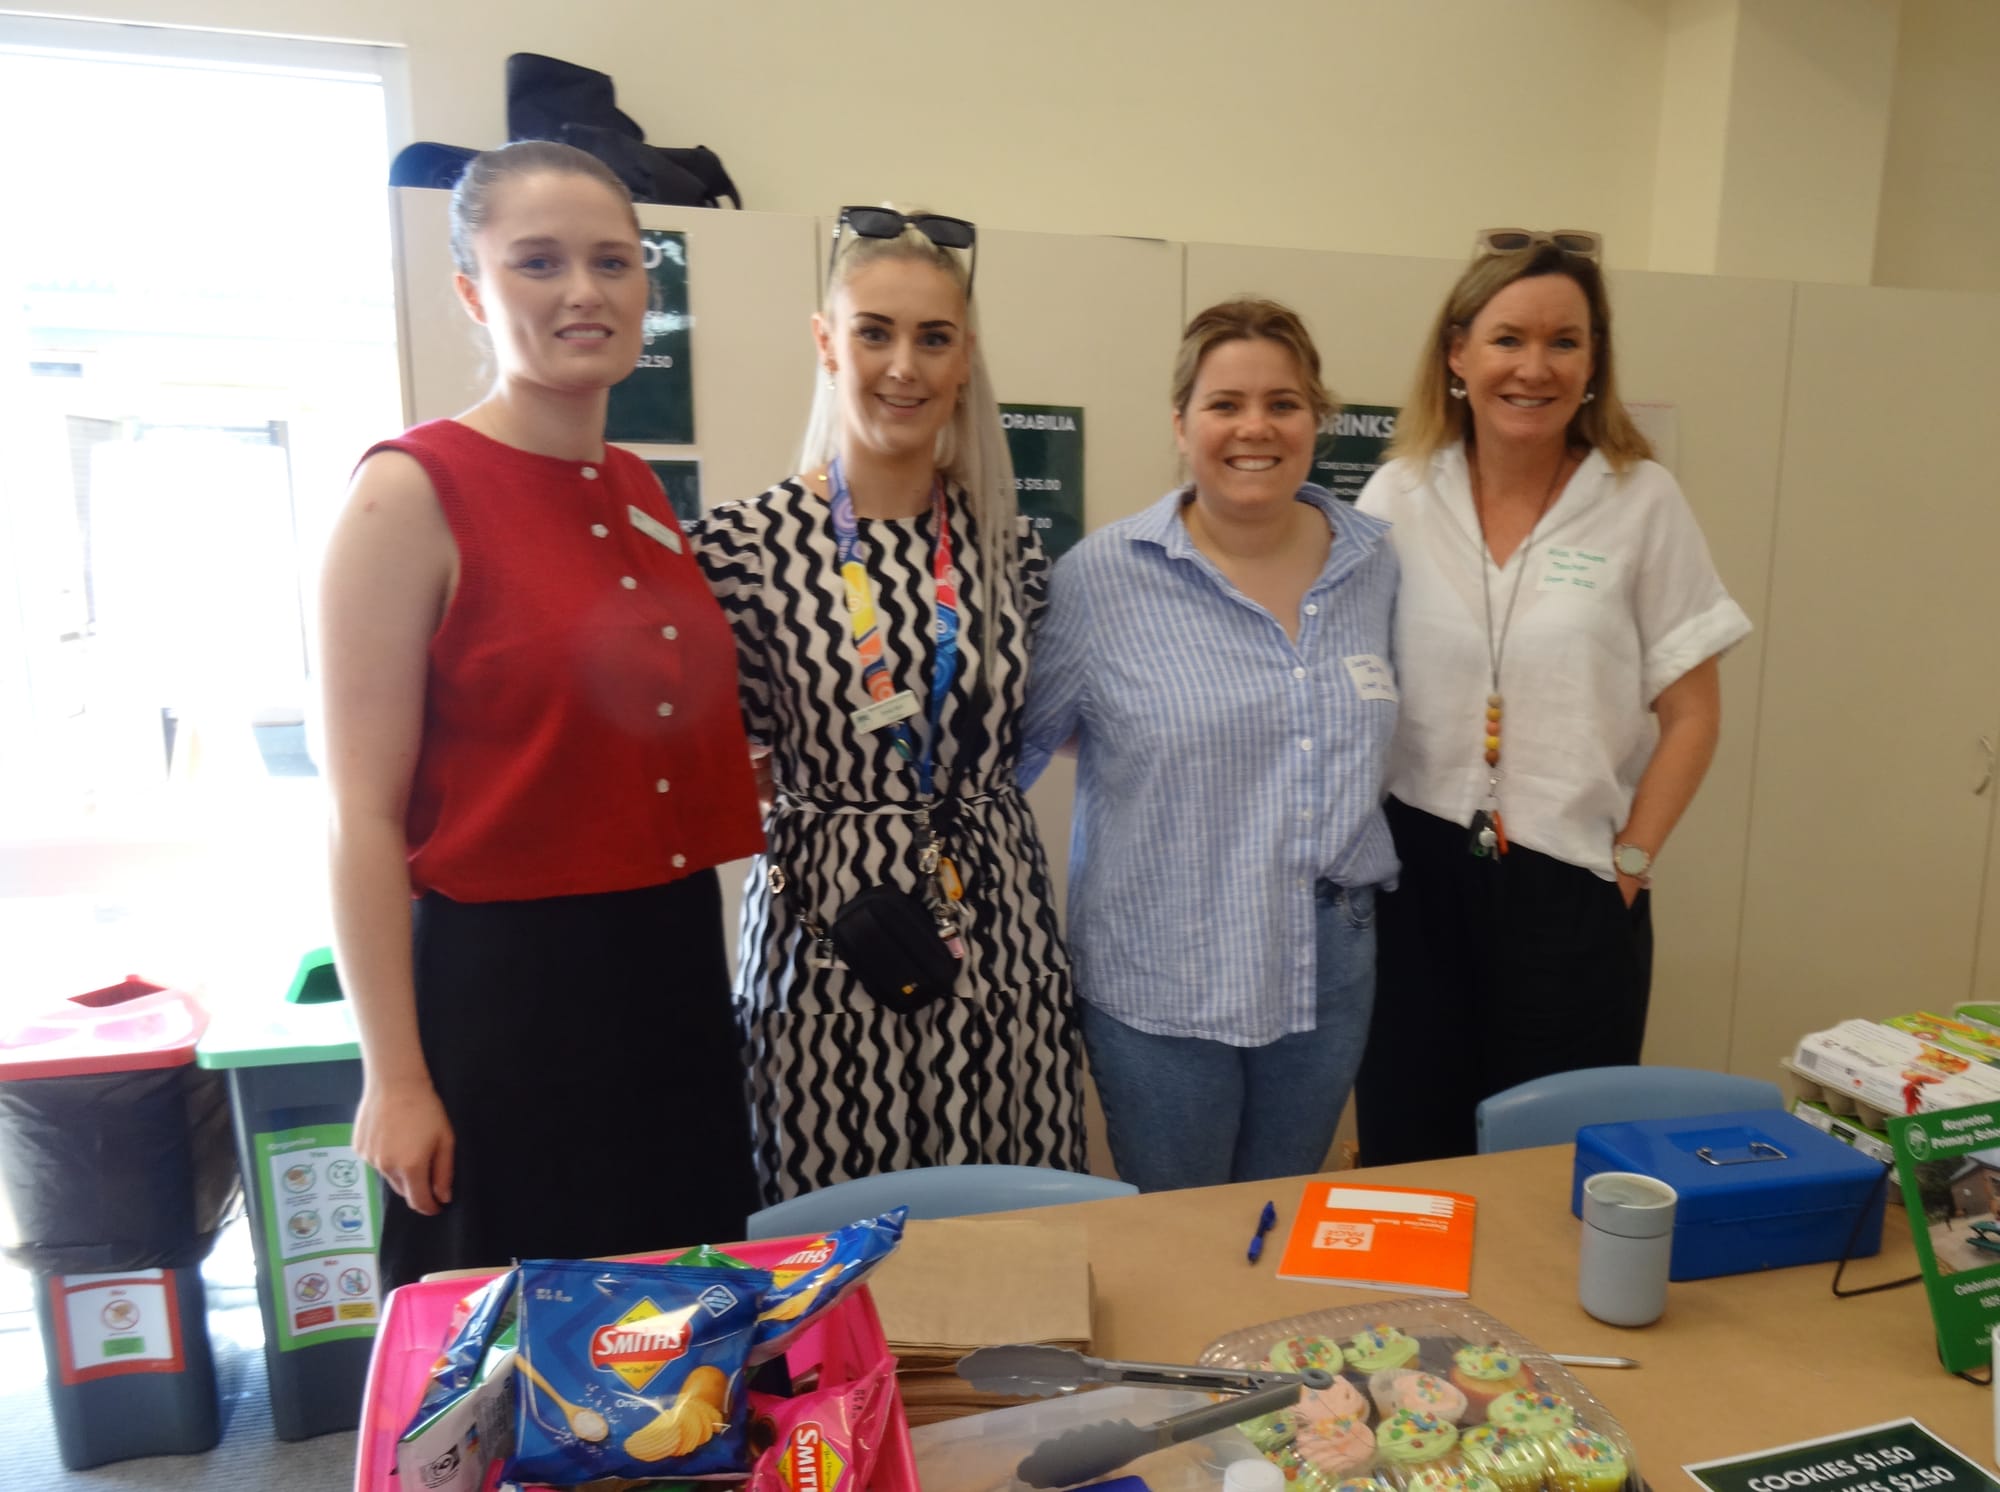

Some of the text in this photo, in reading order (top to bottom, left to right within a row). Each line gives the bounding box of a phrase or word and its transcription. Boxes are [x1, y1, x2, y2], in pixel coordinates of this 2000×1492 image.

[1001, 413, 1076, 431] ORABILIA
[1748, 1446, 1916, 1492] COOKIES $1.50
[1888, 1465, 1956, 1492] $2.50
